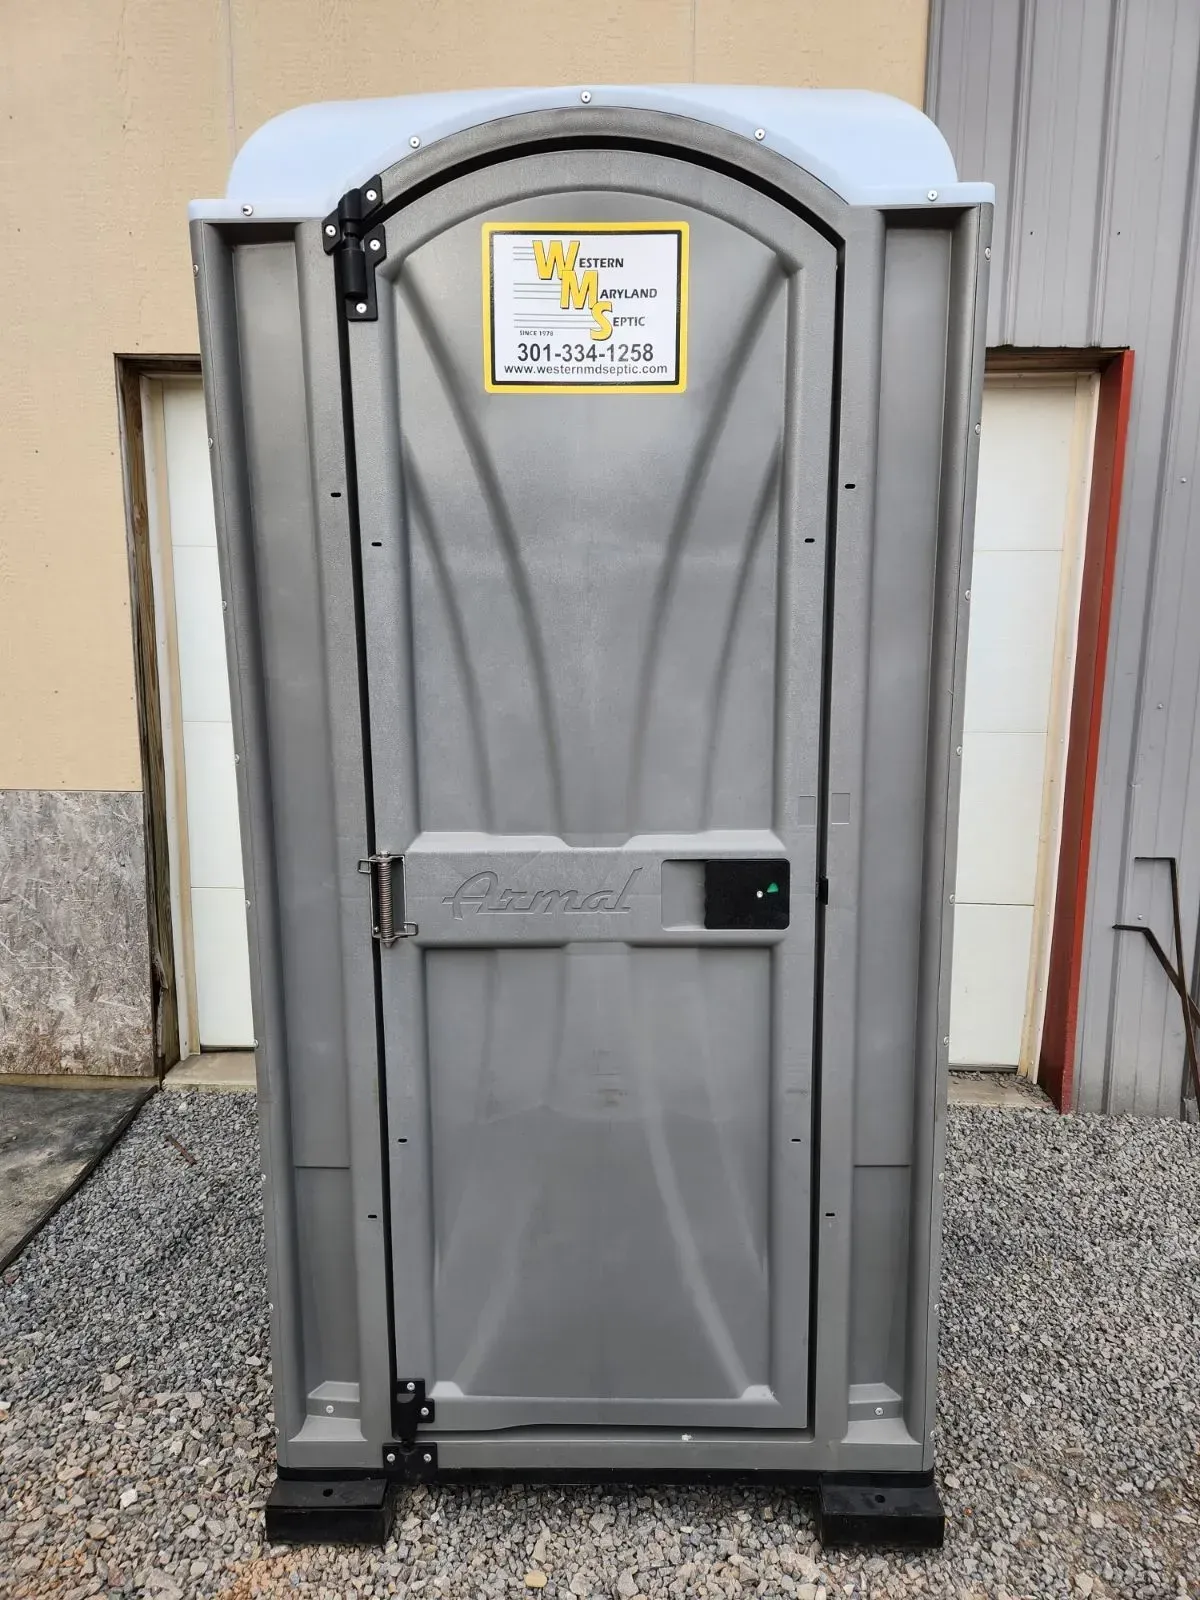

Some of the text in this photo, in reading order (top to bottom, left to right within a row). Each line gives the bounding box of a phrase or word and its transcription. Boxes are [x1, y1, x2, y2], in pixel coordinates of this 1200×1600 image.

[532, 240, 624, 280] WESTERN
[560, 270, 657, 309] MARYLAND
[590, 301, 645, 341] SEPTIC
[504, 363, 668, 376] www.westernmdseptic.com
[517, 343, 654, 362] 301-334-1258
[442, 867, 643, 921] Armal
